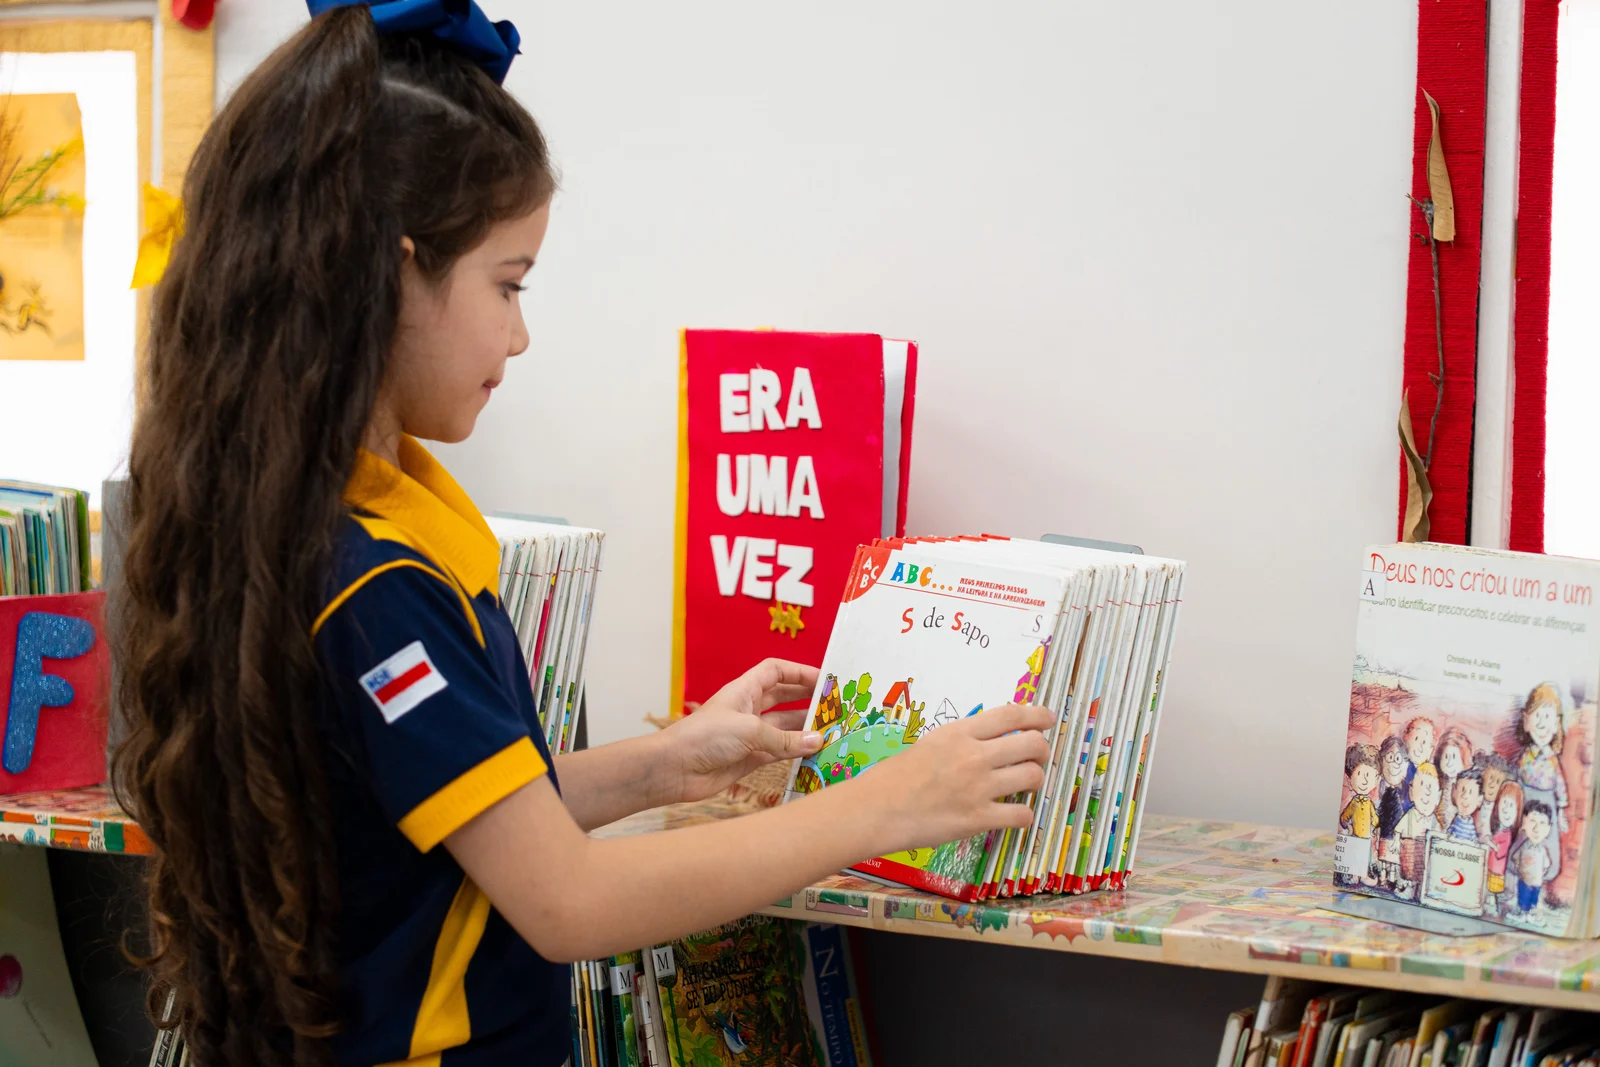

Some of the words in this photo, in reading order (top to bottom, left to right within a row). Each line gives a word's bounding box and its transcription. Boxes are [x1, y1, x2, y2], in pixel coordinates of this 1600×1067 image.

[719, 367, 822, 433] ERA
[716, 453, 825, 519] UMA
[710, 534, 814, 608] VEZ
[1370, 552, 1418, 584] Deus
[1422, 566, 1455, 588] nos
[1460, 567, 1508, 596] criou
[1512, 577, 1541, 599] um
[1545, 581, 1557, 602] a
[1563, 583, 1593, 607] um
[966, 587, 989, 598] LEITURA
[1002, 594, 1046, 607] APRENDIZAGEM
[1006, 585, 1028, 595] PASSOS
[1363, 578, 1376, 597] A
[1032, 614, 1043, 633] S
[1398, 596, 1437, 612] identificar
[1437, 604, 1489, 620] preconceitos
[1490, 611, 1496, 620] e
[1497, 611, 1532, 626] celebrar
[900, 607, 915, 634] S
[922, 606, 945, 628] de
[950, 611, 990, 649] Sapo
[2, 611, 97, 775] F
[1434, 846, 1456, 858] NOSSA
[1456, 851, 1480, 864] CLASSE
[656, 952, 670, 971] M
[620, 970, 633, 990] M
[686, 989, 700, 1010] SE
[702, 984, 720, 1006] EU
